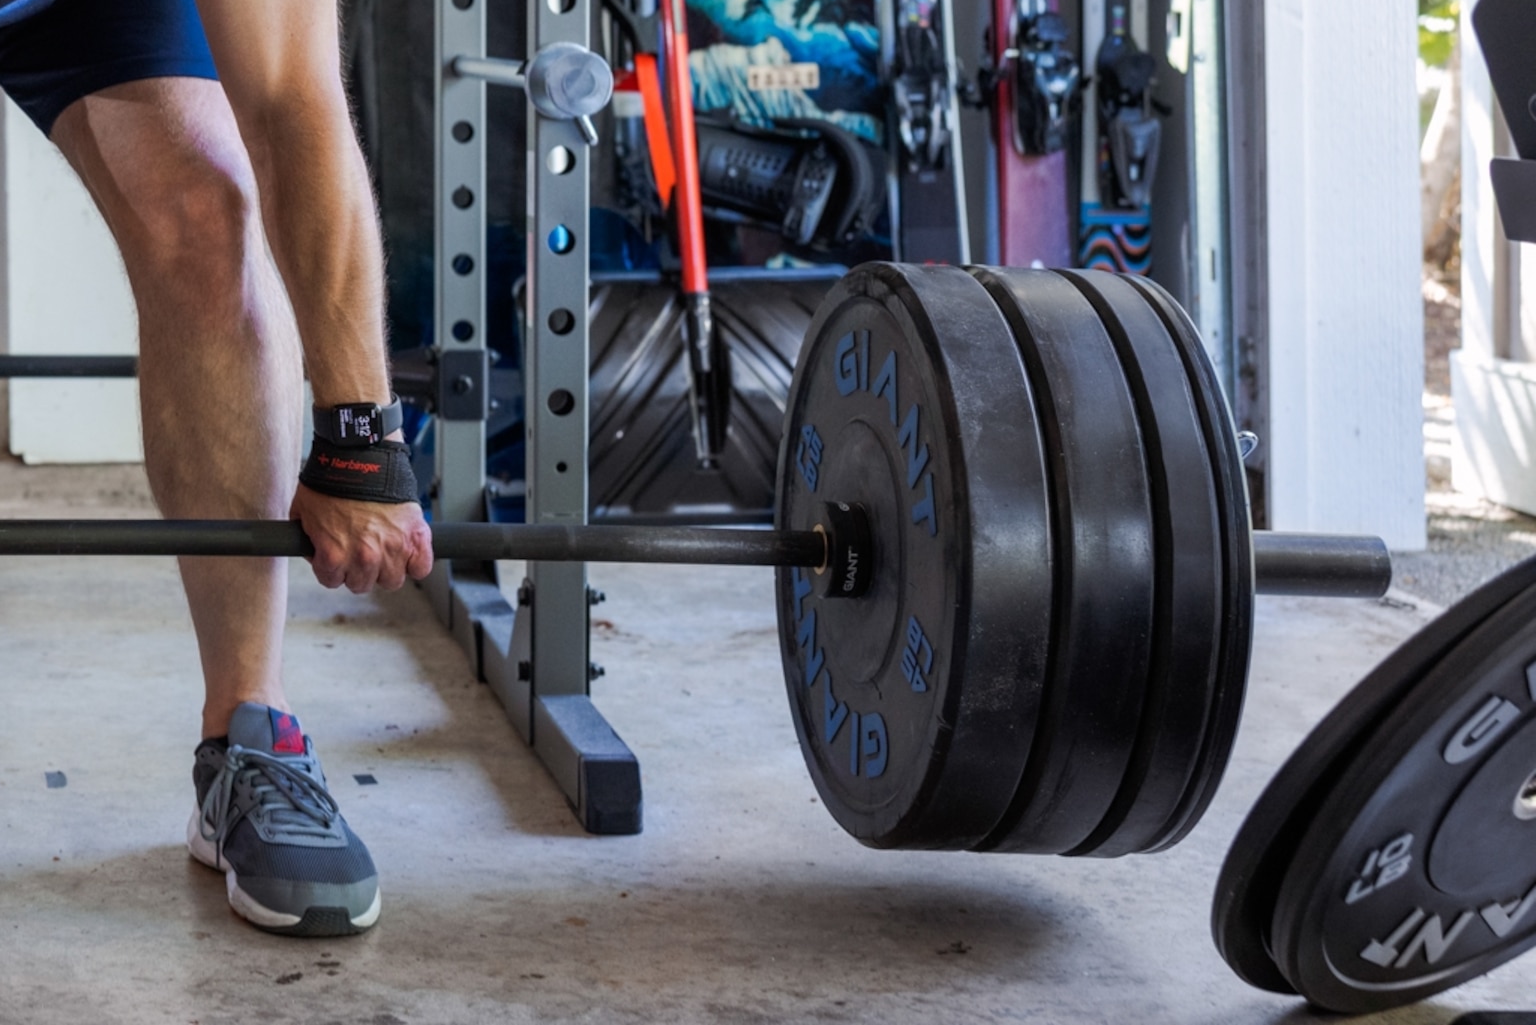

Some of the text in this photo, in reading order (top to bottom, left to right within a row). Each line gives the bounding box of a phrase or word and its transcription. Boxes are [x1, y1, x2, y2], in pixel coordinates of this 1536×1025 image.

[358, 415, 372, 437] 3:12
[802, 424, 824, 465] 45
[834, 330, 937, 537] GIANT
[330, 457, 382, 474] Harbinger
[796, 442, 818, 493] LB
[843, 549, 859, 592] GIANT
[907, 615, 933, 675] LB
[792, 565, 889, 779] GIANT
[900, 646, 927, 693] 45
[1362, 833, 1414, 877] 10
[1345, 855, 1412, 905] LB
